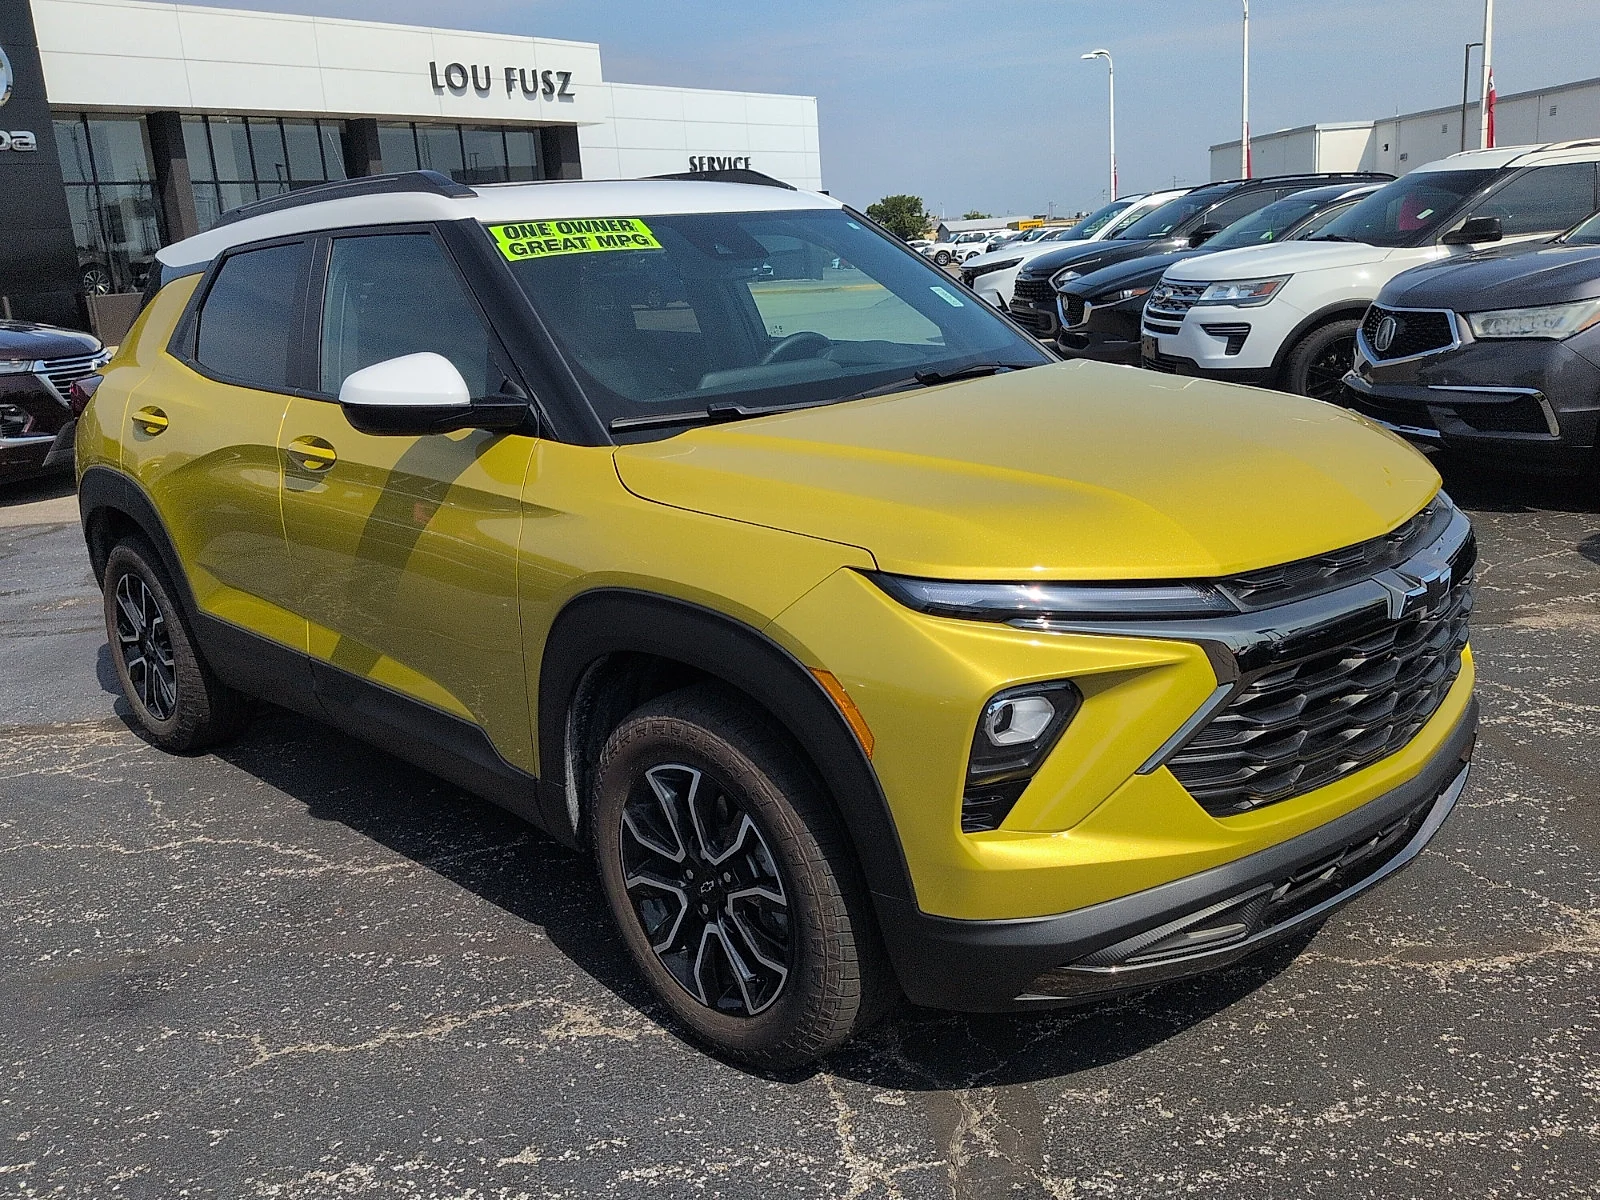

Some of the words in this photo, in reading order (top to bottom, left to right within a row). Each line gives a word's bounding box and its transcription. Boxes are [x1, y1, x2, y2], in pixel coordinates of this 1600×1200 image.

[429, 61, 491, 92] LOU
[504, 67, 575, 97] FUSZ
[689, 155, 752, 172] SERVICE
[503, 222, 553, 240] ONE
[555, 219, 636, 234] OWNER
[508, 236, 591, 256] GREAT
[595, 233, 651, 248] MPG
